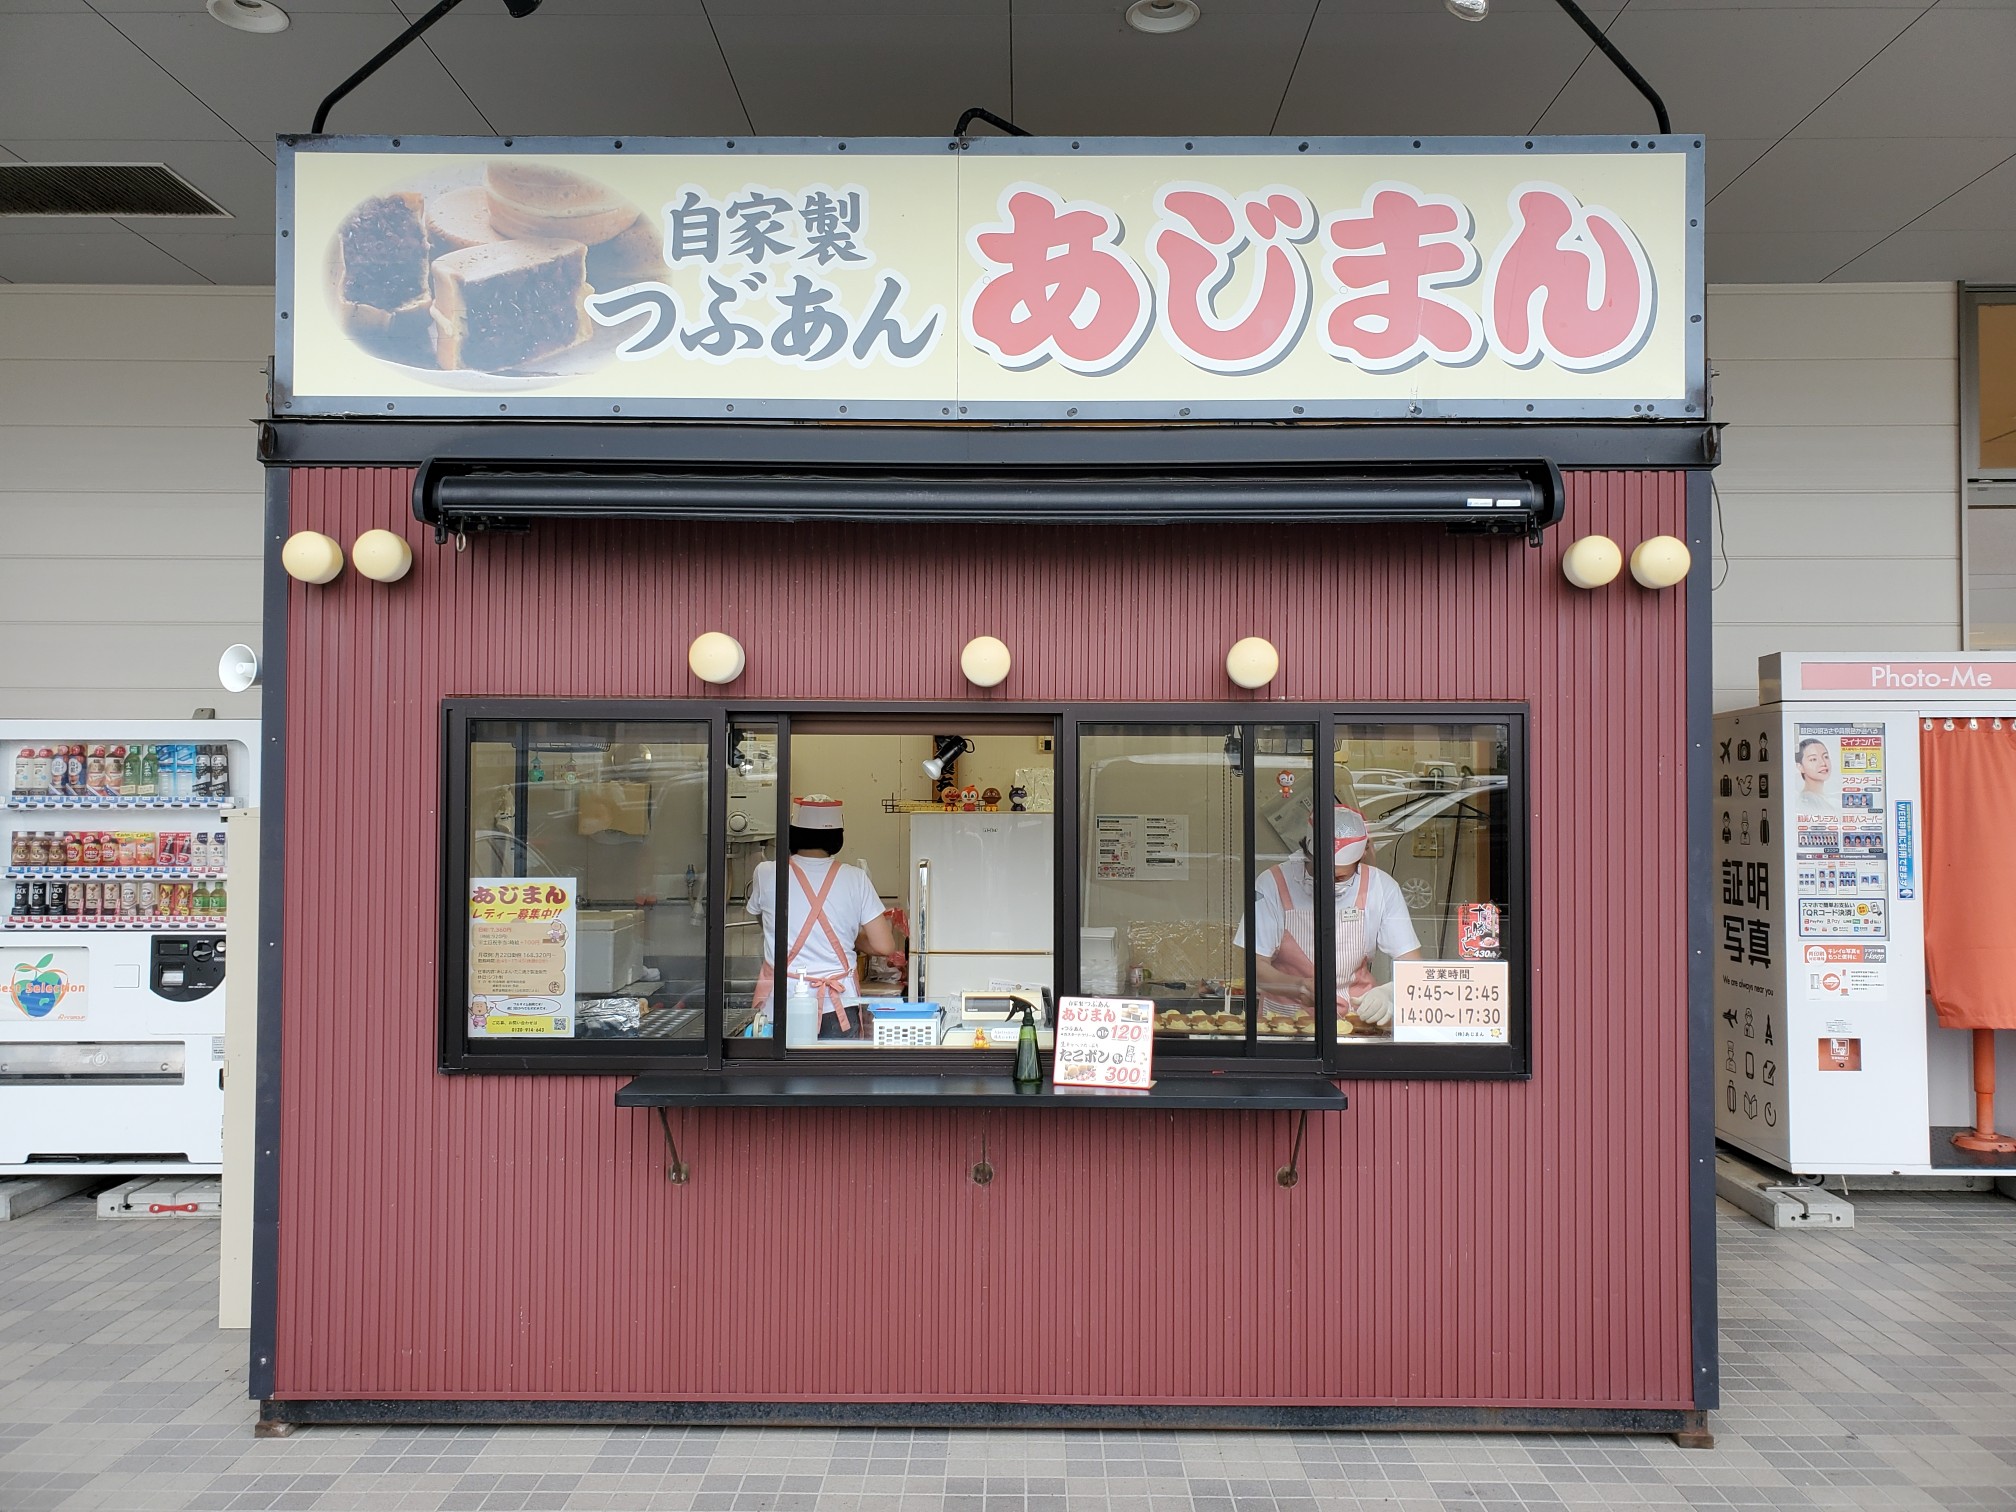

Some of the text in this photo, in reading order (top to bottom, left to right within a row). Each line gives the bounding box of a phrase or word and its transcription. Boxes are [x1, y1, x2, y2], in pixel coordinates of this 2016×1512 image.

[668, 191, 868, 266] 自家製
[968, 187, 1645, 366] あじまん
[592, 271, 939, 360] つぶあん
[1871, 664, 1992, 687] Photo-Me
[1842, 738, 1880, 746] マイナンバー
[1842, 776, 1881, 785] スタンダード
[1722, 859, 1769, 911] 証明
[472, 886, 567, 905] あじまん
[472, 908, 563, 920] レディー募集中!!
[1802, 909, 1856, 917] 「QRコード決済」
[1722, 914, 1772, 970] 写真
[1425, 969, 1470, 980] 営業時間
[26, 982, 85, 993] Selection
[1406, 984, 1499, 1002] 9:45~12:45
[1723, 974, 1730, 985] We
[1739, 979, 1754, 993] always
[1754, 985, 1764, 993] near
[1765, 988, 1774, 997] you
[1061, 1007, 1116, 1023] あじまん
[1400, 1007, 1500, 1025] 14:00~17:30
[1111, 1024, 1142, 1041] 120
[1059, 1048, 1110, 1064] たこポン
[1104, 1066, 1141, 1084] 300
